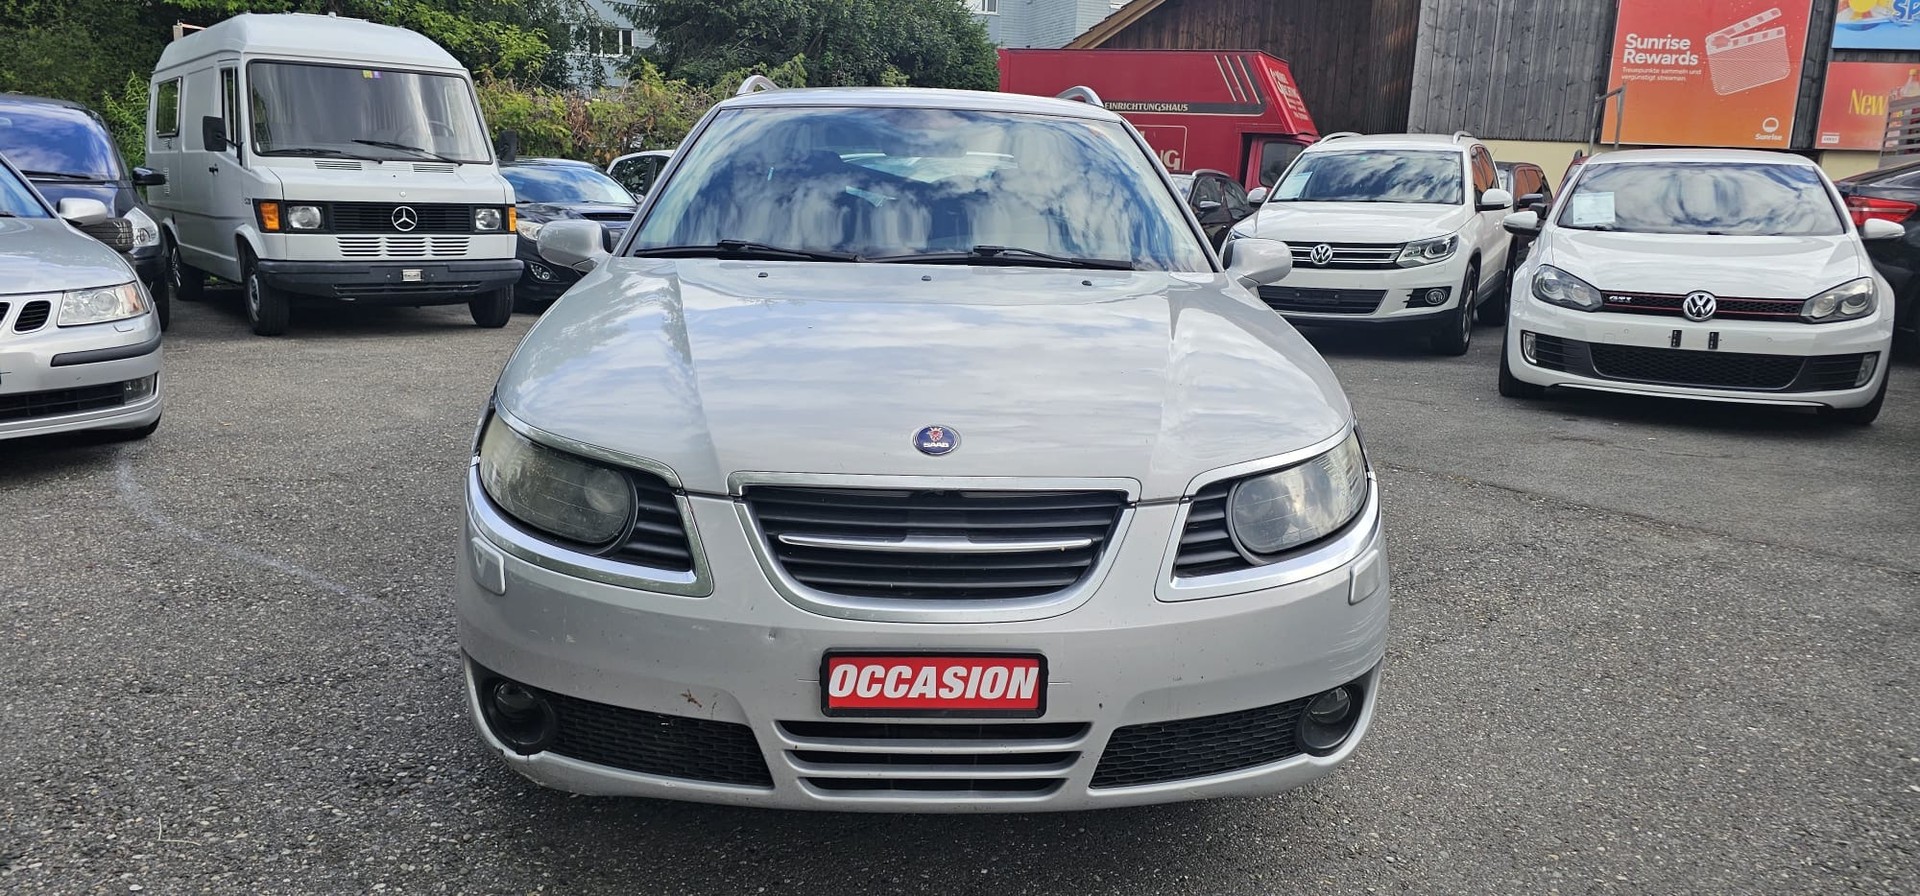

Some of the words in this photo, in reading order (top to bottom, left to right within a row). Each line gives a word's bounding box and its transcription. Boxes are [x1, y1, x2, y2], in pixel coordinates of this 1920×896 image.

[1625, 33, 1691, 50] Sunrise
[1623, 49, 1699, 66] Rewards
[1104, 101, 1189, 112] EINRICHTUNGSHAUS
[1848, 88, 1888, 116] New
[1754, 133, 1783, 141] Sunrise
[1684, 292, 1716, 321] VW
[828, 663, 1040, 700] OCCASION
